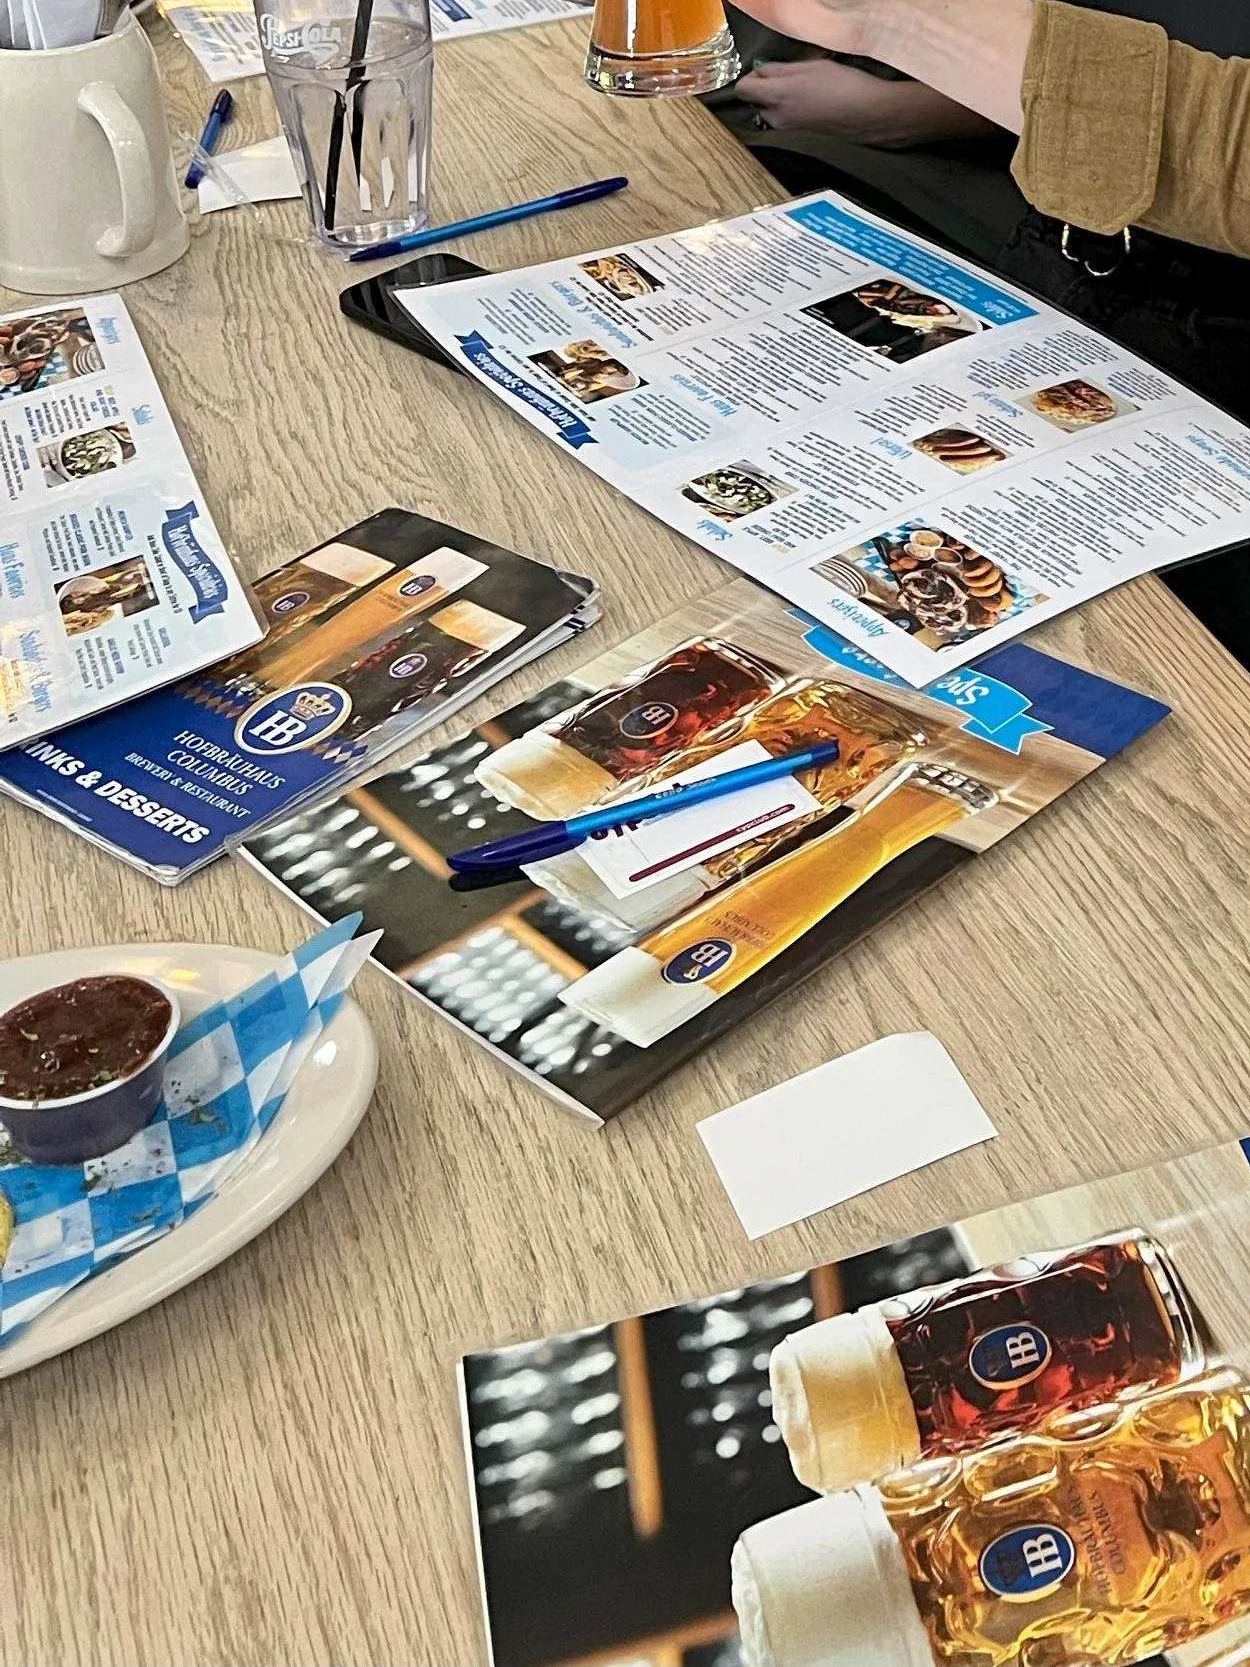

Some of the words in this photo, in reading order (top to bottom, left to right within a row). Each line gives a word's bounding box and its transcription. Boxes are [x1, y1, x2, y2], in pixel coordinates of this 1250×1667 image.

[245, 710, 311, 748] HB
[641, 704, 673, 727] HB
[166, 750, 253, 796] COLUMBUS
[173, 730, 287, 790] HOFBRÄUHAUS
[80, 765, 104, 791] &
[95, 773, 210, 846] DESSERTS
[125, 752, 172, 786] BREWERY
[181, 780, 252, 820] RESTAURANT
[691, 943, 729, 968] HB
[1004, 1330, 1041, 1370] HB
[1022, 1532, 1063, 1578] HB
